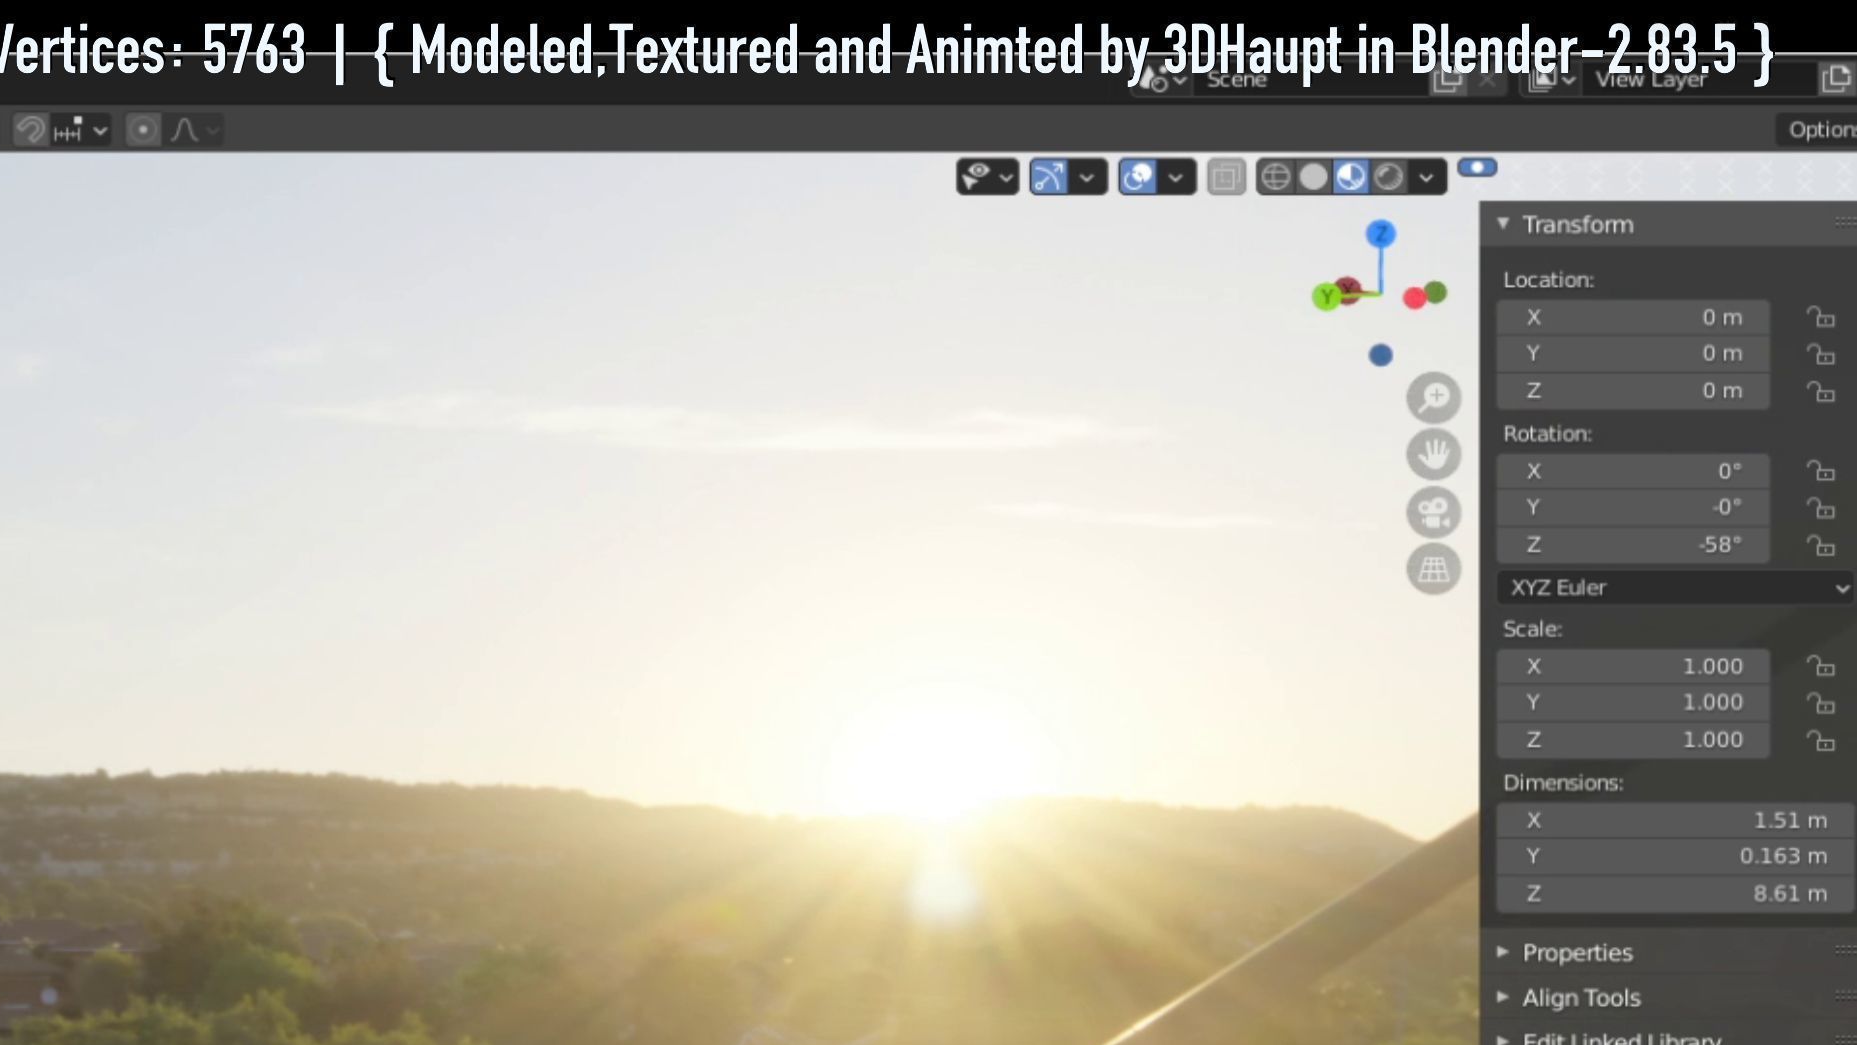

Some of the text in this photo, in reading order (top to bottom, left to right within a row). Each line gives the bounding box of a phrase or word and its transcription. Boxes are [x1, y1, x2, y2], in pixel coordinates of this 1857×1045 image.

[1208, 70, 1267, 88] Scene
[1596, 69, 1709, 93] View Layer
[1790, 120, 1857, 143] Option
[1522, 214, 1634, 234] Transform
[1376, 225, 1387, 242] Z
[1504, 271, 1595, 289] Location:
[1321, 289, 1334, 304] Y
[1527, 309, 1743, 326] X 0 m
[1527, 345, 1743, 362] Y 0 m
[1527, 382, 1743, 399] Z 0 m
[1504, 425, 1593, 443] Rotation:
[1527, 463, 1743, 480] X 0°
[1527, 499, 1743, 516] Y -0°
[1527, 536, 1743, 553] Z -58°
[1511, 577, 1607, 597] XYZ Euler
[1504, 620, 1563, 638] Scale:
[1527, 659, 1744, 676] X 1.000
[1527, 695, 1744, 712] Y 1.000
[1527, 732, 1744, 749] Z 1.000
[1504, 774, 1624, 793] Dimensions:
[1527, 813, 1828, 830] X 1.51 m
[1527, 848, 1828, 866] Y 0.163 m
[1527, 885, 1828, 903] Z 8.61 m
[1523, 943, 1634, 965] Properties
[1523, 987, 1642, 1010] Align Tools
